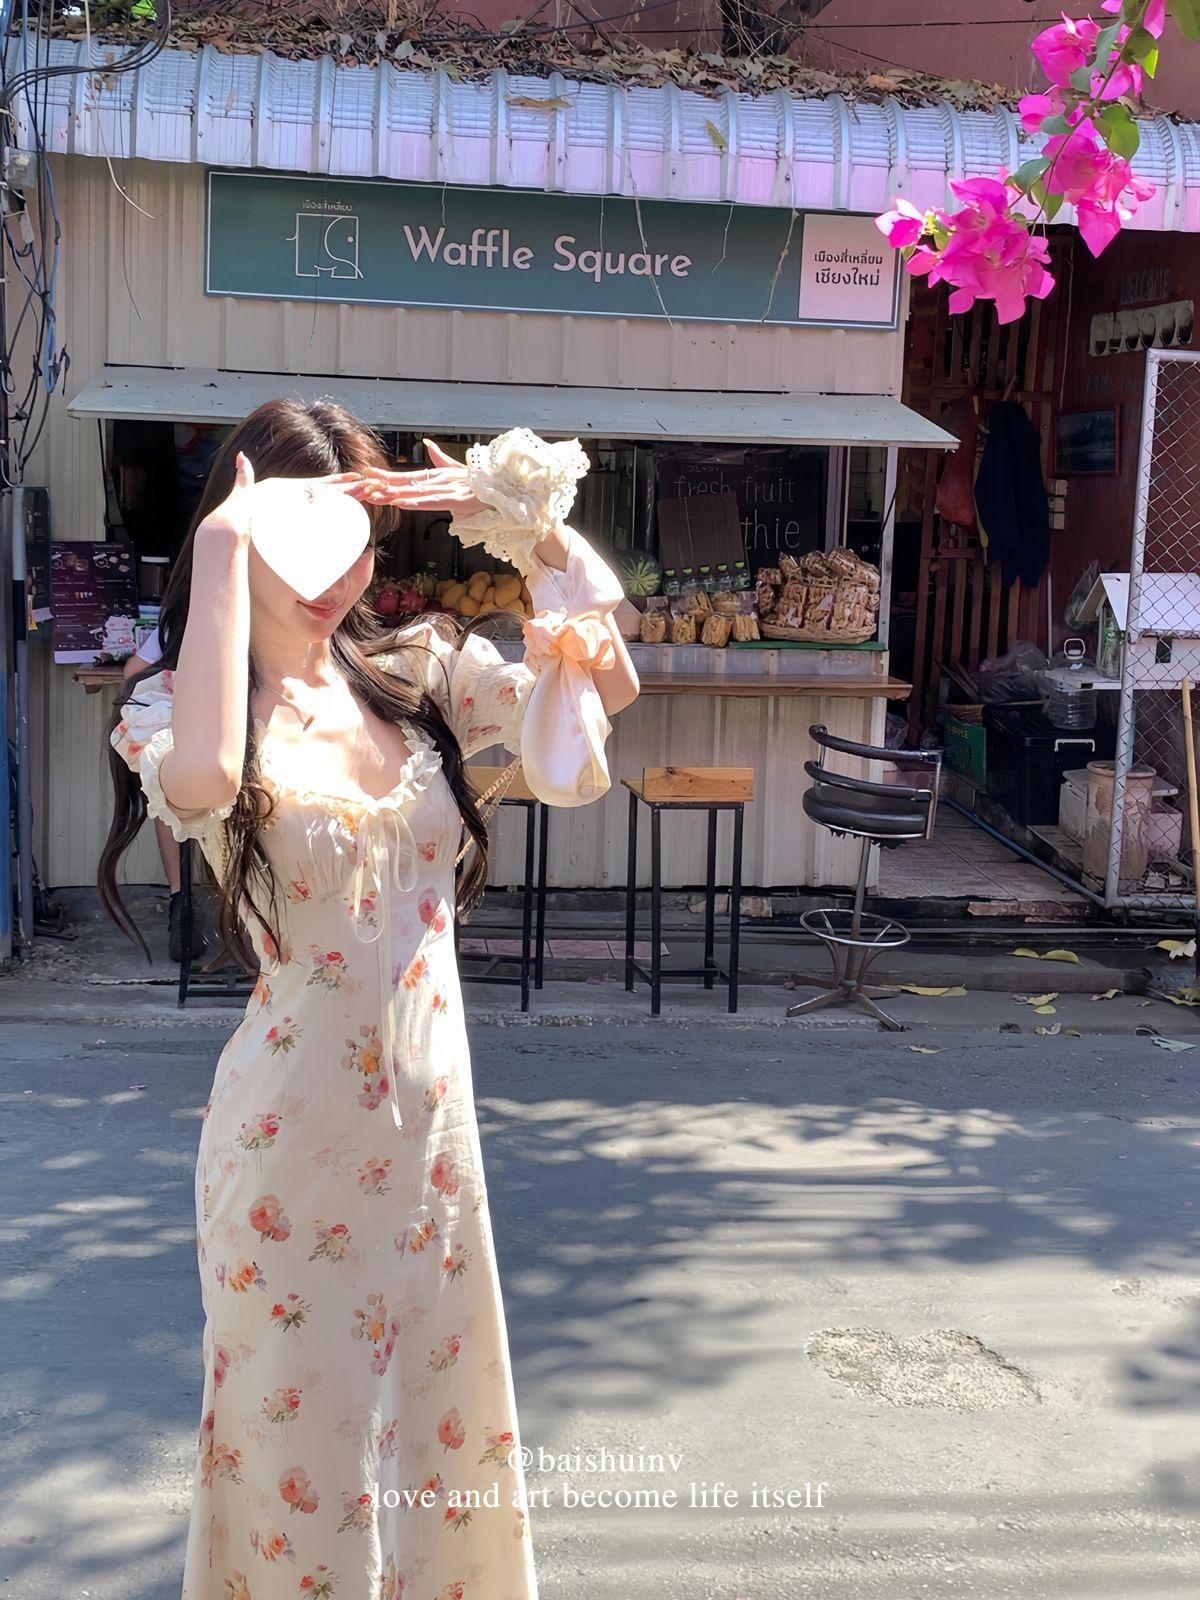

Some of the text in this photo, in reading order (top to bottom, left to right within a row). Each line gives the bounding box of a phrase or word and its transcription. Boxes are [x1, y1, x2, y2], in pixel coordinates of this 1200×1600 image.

[403, 225, 692, 283] Waffle Square
[816, 267, 880, 286] เชียงใหม่
[742, 475, 795, 503] fruit
[739, 508, 801, 551] thie
